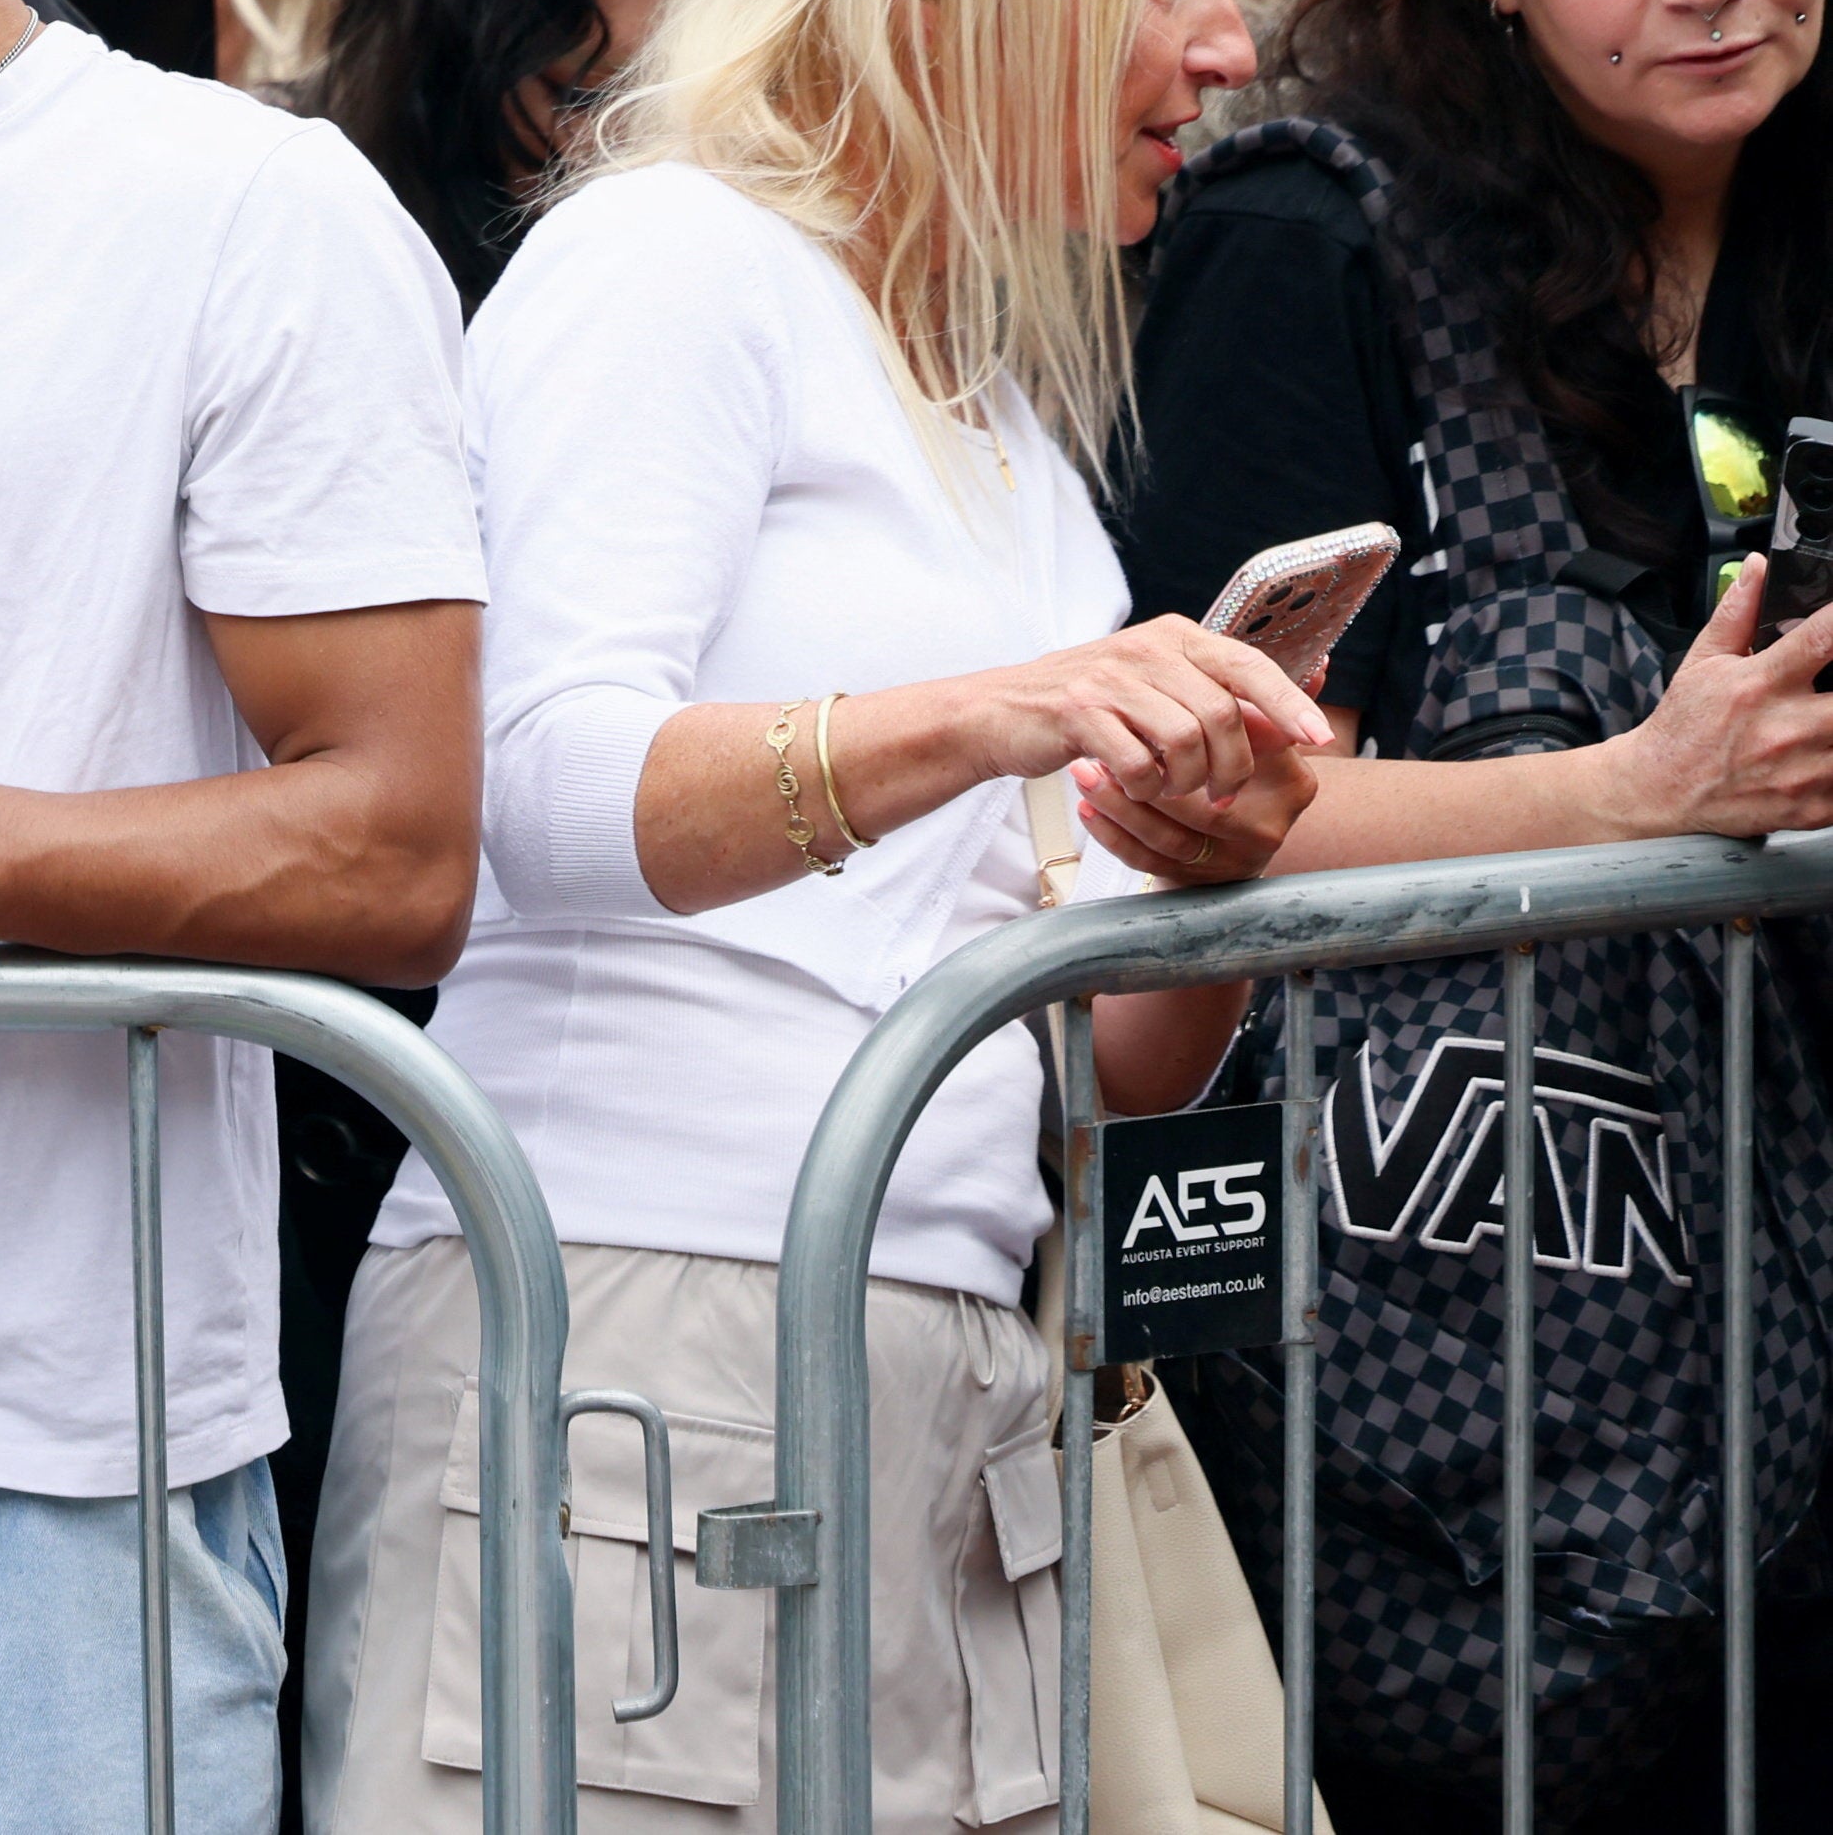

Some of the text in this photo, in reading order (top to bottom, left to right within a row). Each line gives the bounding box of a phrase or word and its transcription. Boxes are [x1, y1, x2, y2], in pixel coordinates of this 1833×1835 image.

[1121, 1161, 1267, 1250] AES
[1121, 1236, 1266, 1265] AUGUSTA EVENT SUPPORT
[1122, 1273, 1266, 1307] info@aesteam.co.uk
